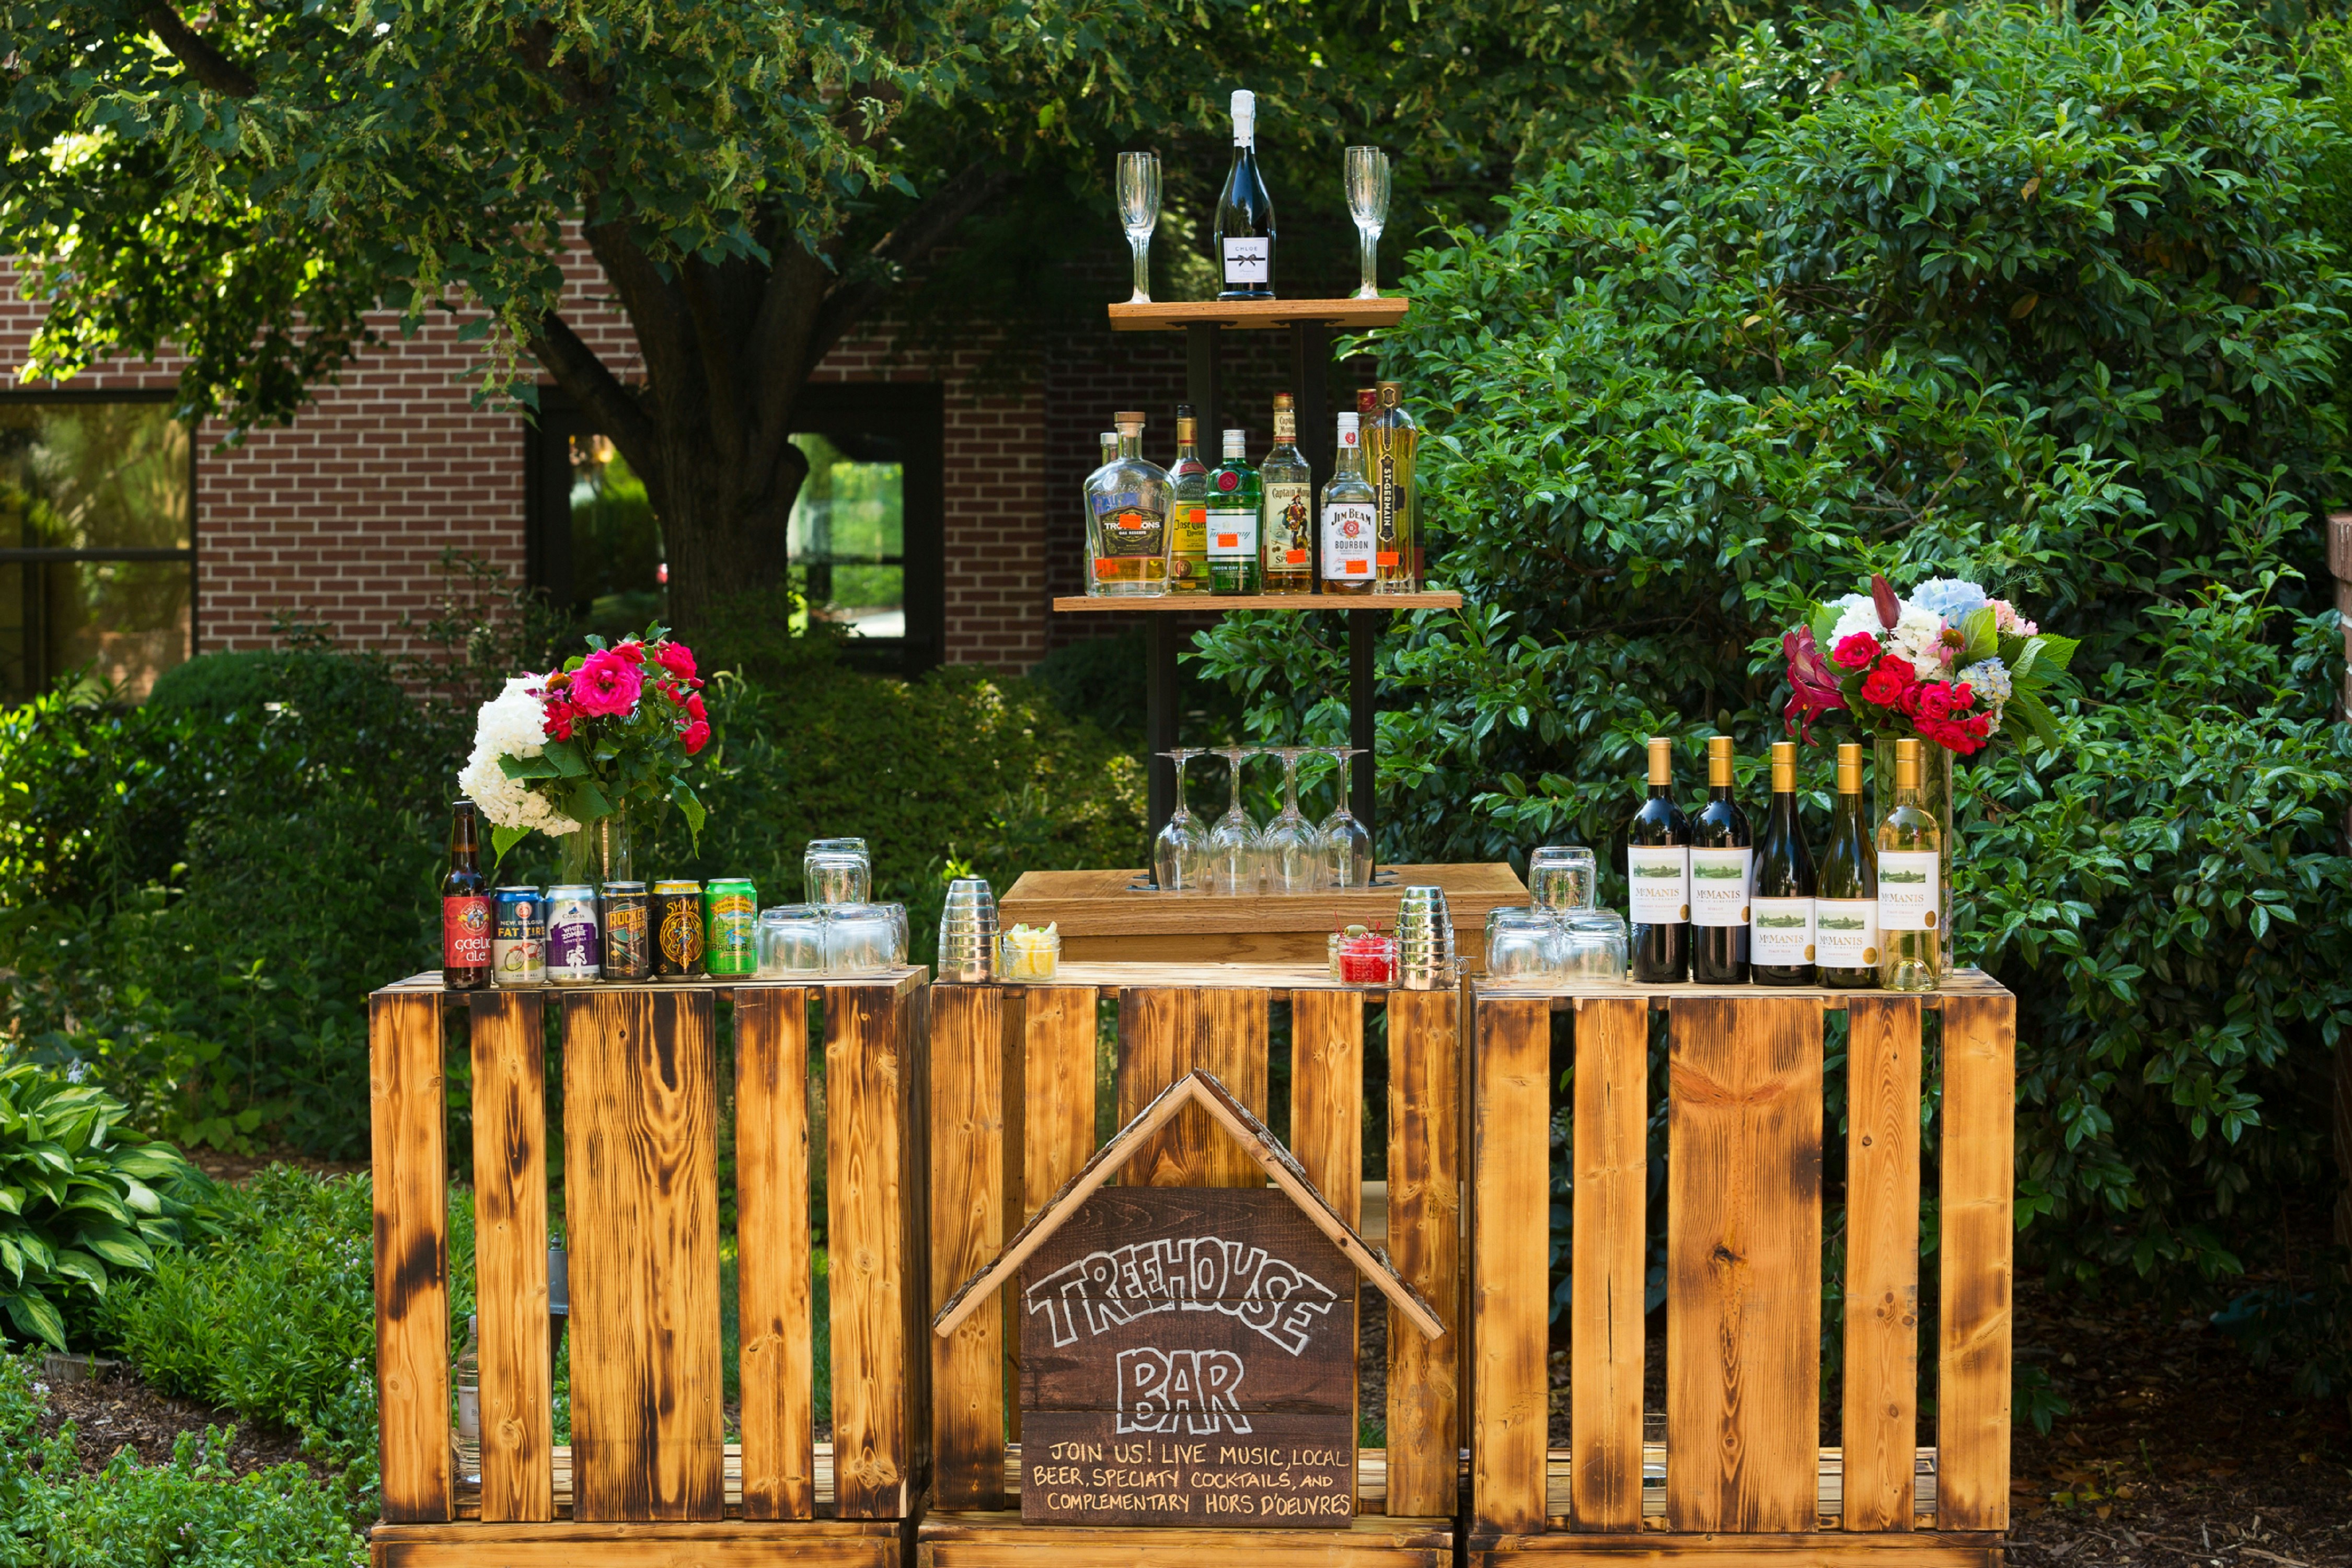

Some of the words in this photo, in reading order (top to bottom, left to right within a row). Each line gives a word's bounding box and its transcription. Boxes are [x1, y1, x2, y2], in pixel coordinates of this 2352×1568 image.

[1272, 487, 1295, 500] Captain
[1383, 467, 1392, 526] ST-GERMAIN
[1331, 511, 1347, 526] JIM
[1349, 508, 1371, 526] BEAM
[1335, 540, 1368, 549] BOURBON
[609, 908, 645, 928] ROCKET
[628, 921, 645, 932] GIRL
[498, 927, 520, 937] FAT
[524, 926, 545, 937] TIRE
[563, 925, 584, 933] WHITE
[711, 943, 737, 951] PALE
[741, 942, 756, 951] ALE
[466, 950, 486, 962] ale
[1025, 1236, 1337, 1356] TREEHOUSE
[1116, 1347, 1252, 1435] BAR
[1048, 1441, 1102, 1463] JOIN
[1114, 1439, 1152, 1464] US!
[1162, 1443, 1207, 1464] LIVE
[1292, 1449, 1350, 1467] LOCAL
[1033, 1465, 1090, 1488] BEER,
[1191, 1471, 1297, 1491] COCKTAILS,
[1299, 1474, 1333, 1488] AND
[1047, 1492, 1190, 1513] COMPLEMENTARY
[1206, 1493, 1254, 1514] HORS
[1260, 1492, 1351, 1516] D'OEUVRES
